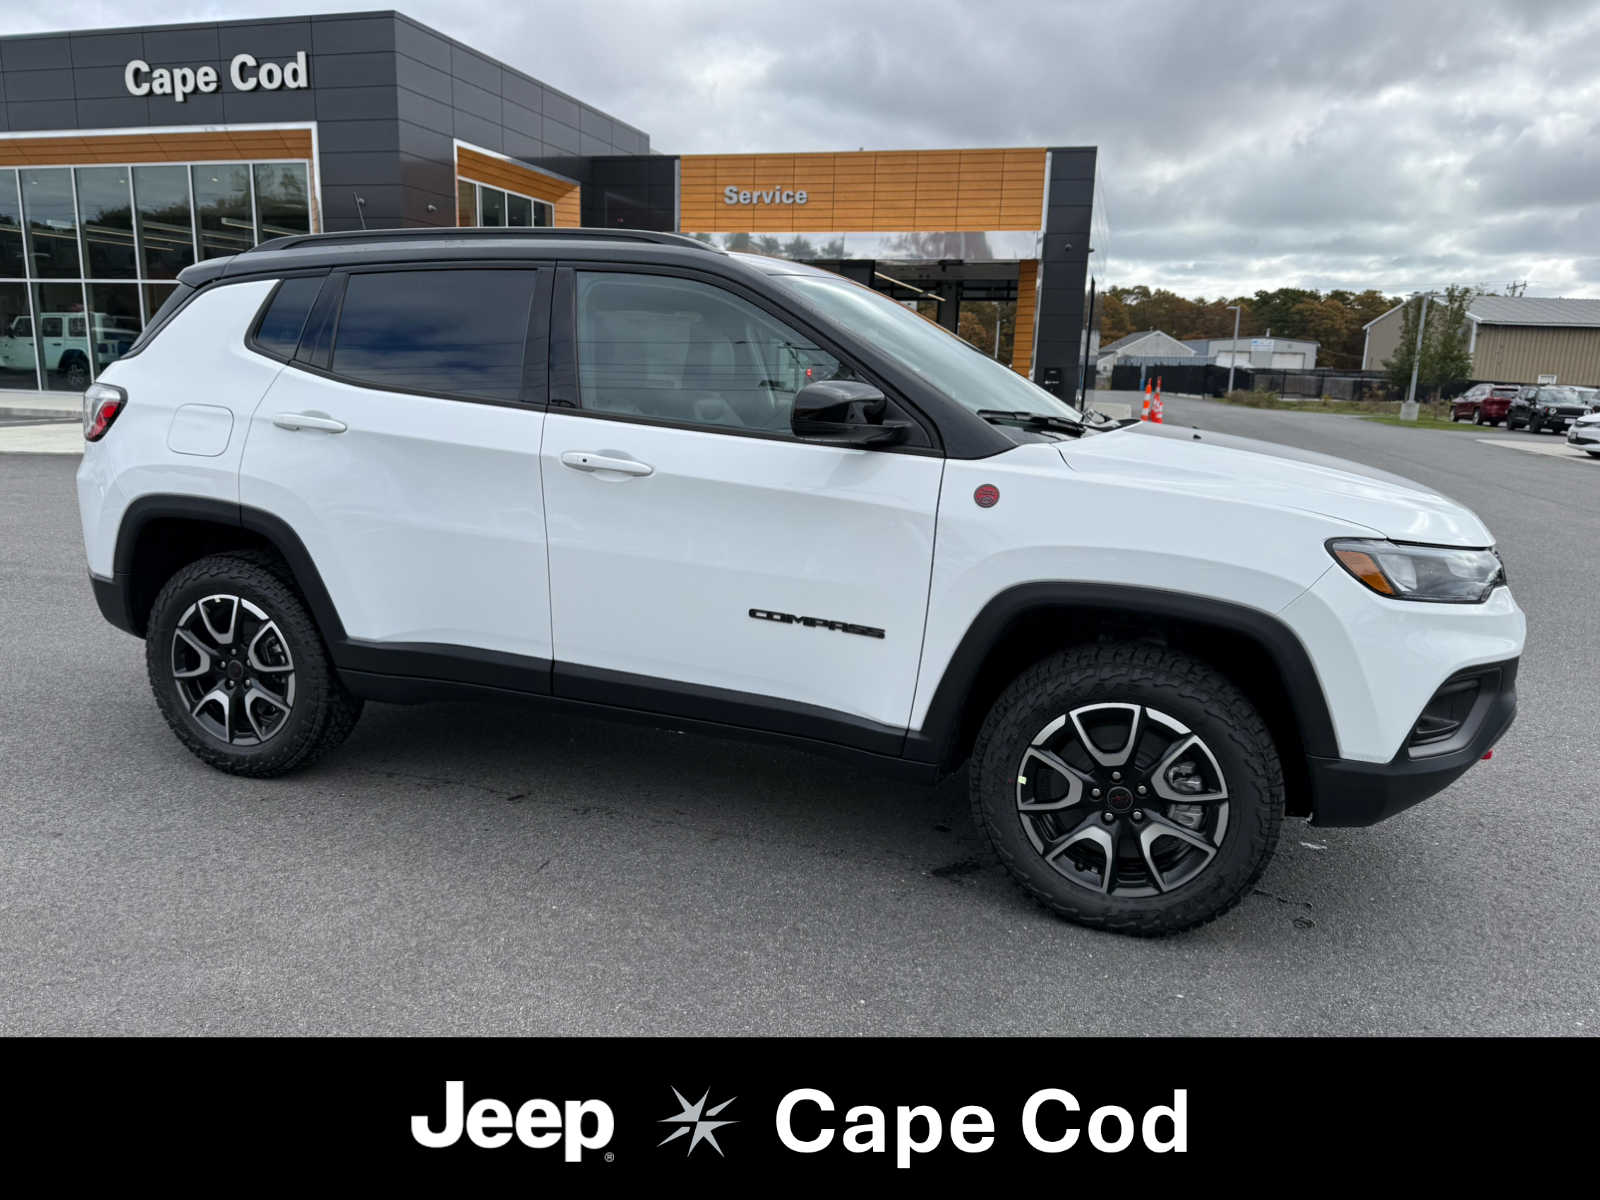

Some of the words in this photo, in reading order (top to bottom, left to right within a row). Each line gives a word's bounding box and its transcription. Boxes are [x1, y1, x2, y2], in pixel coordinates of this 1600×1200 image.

[124, 59, 218, 102] Cape
[230, 50, 308, 92] Cod
[723, 185, 808, 205] Service
